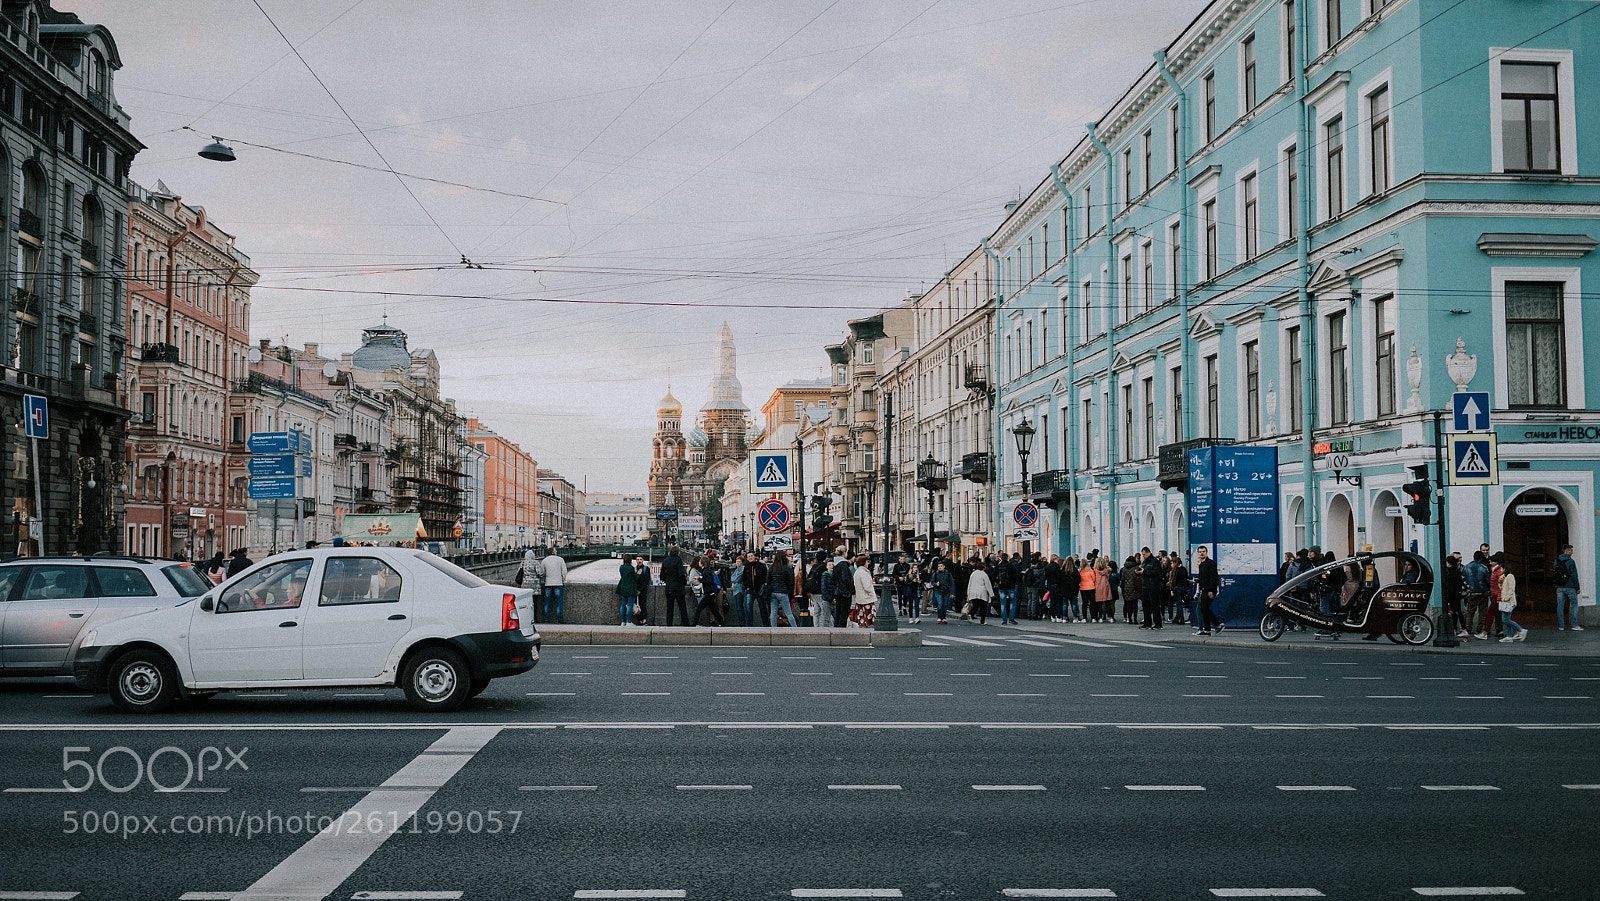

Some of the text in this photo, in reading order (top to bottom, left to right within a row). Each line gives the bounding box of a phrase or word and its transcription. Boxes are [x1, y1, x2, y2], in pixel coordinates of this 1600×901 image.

[1524, 426, 1600, 440] СТАНЦИЯ НЕВСК
[1231, 459, 1235, 467] 1
[1231, 472, 1238, 480] 3
[1251, 472, 1259, 480] 2
